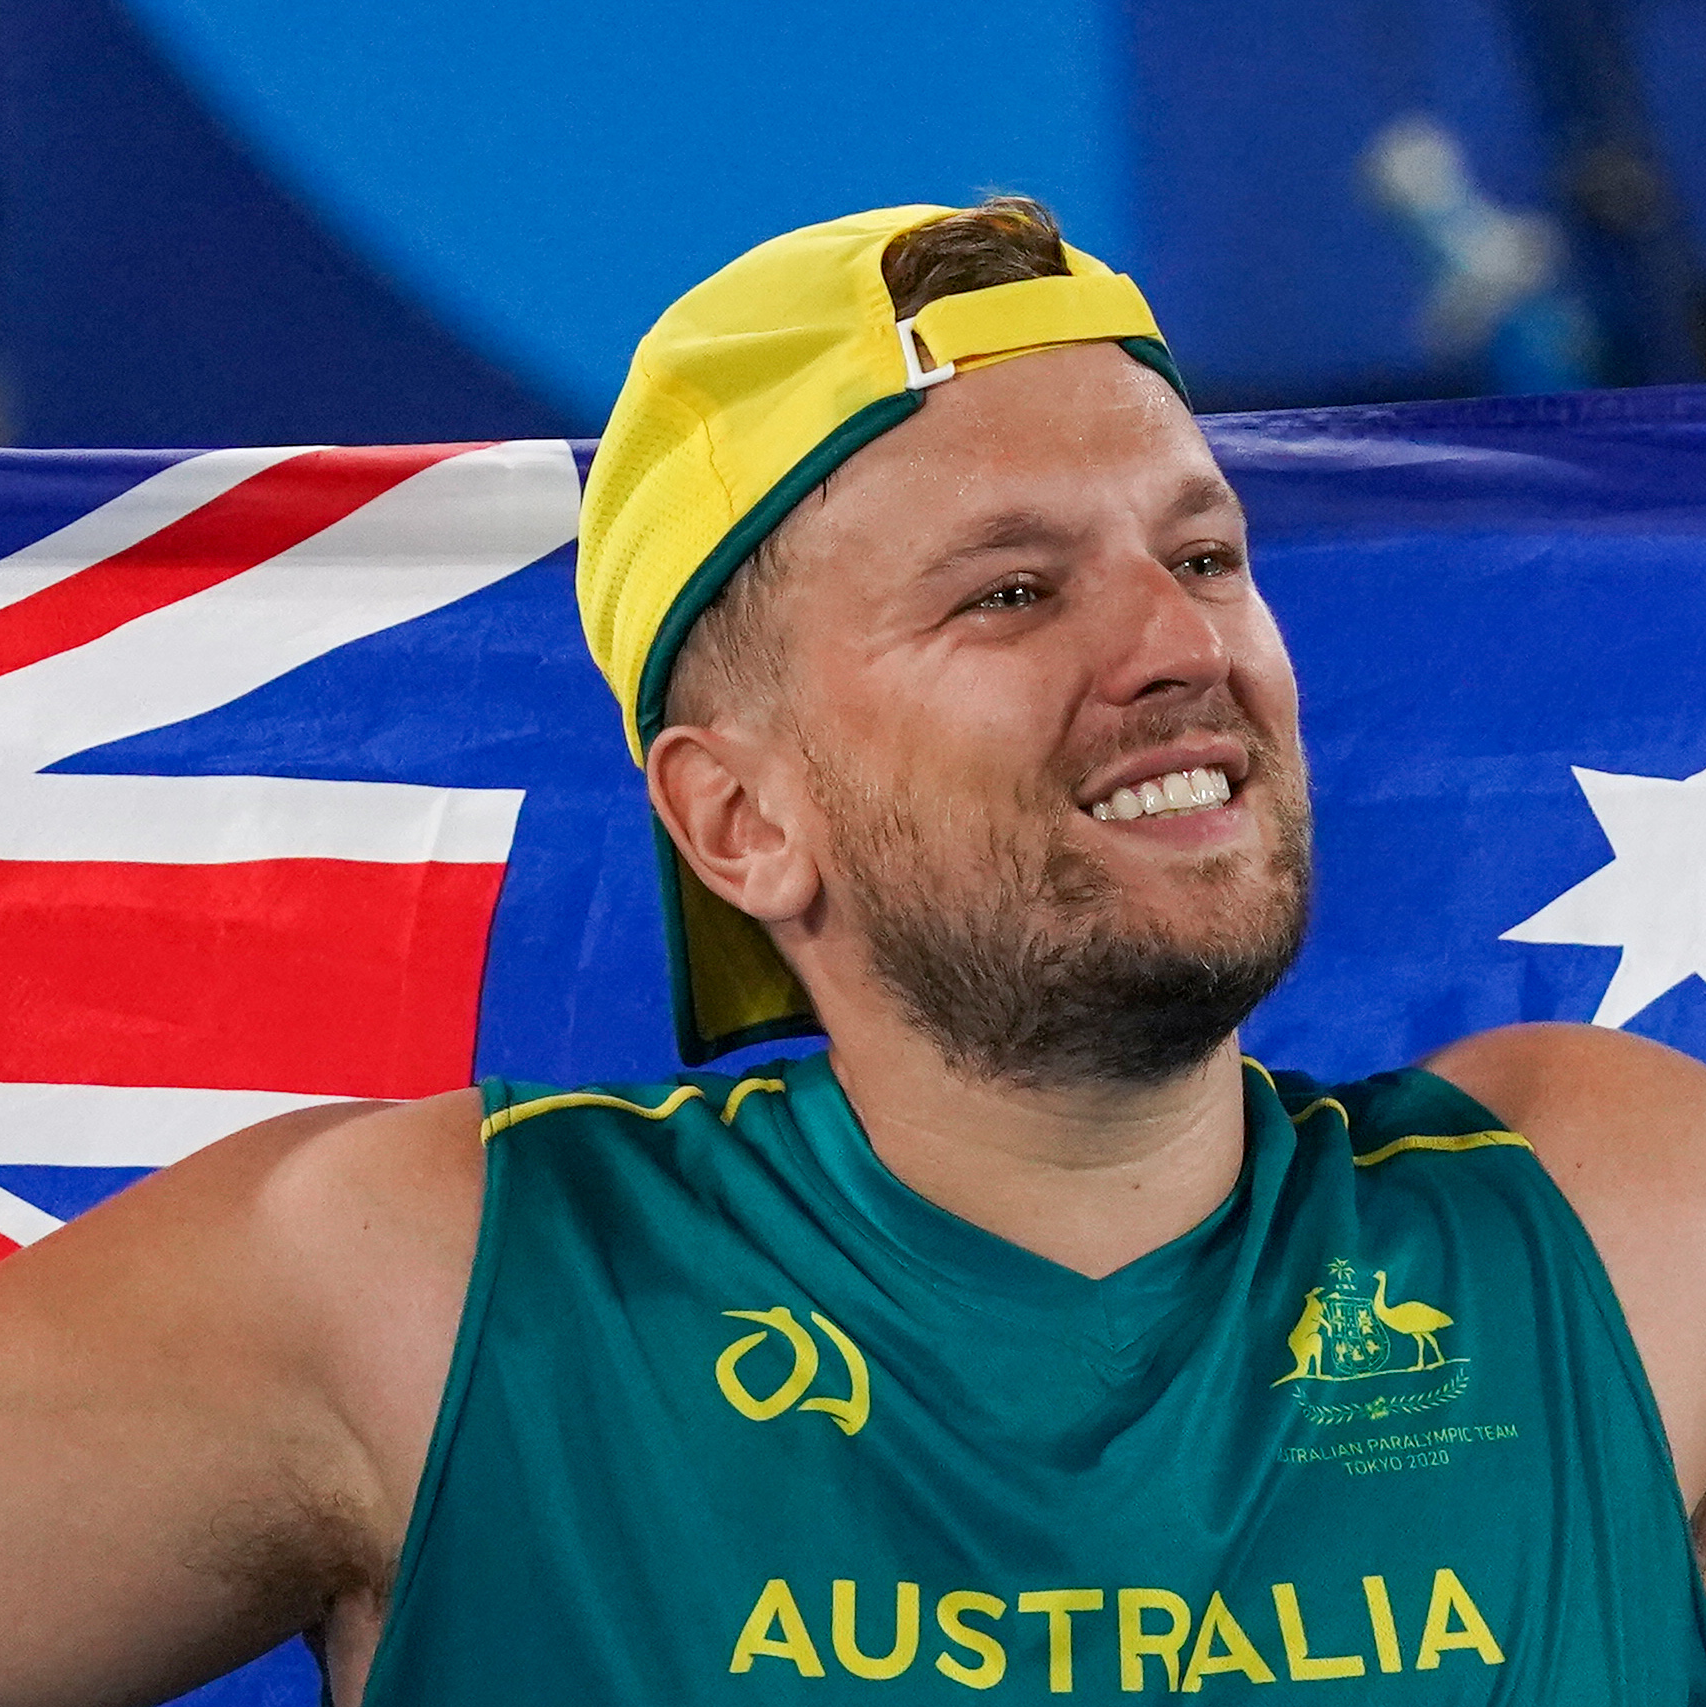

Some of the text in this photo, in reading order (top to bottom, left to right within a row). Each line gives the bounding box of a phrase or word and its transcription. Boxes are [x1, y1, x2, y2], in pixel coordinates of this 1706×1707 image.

[1366, 1427, 1473, 1453] PARALYMPIC
[1474, 1423, 1519, 1442] TEAM
[1344, 1449, 1450, 1476] TOKYO 2020
[729, 1567, 1505, 1693] AUSTRALIA
